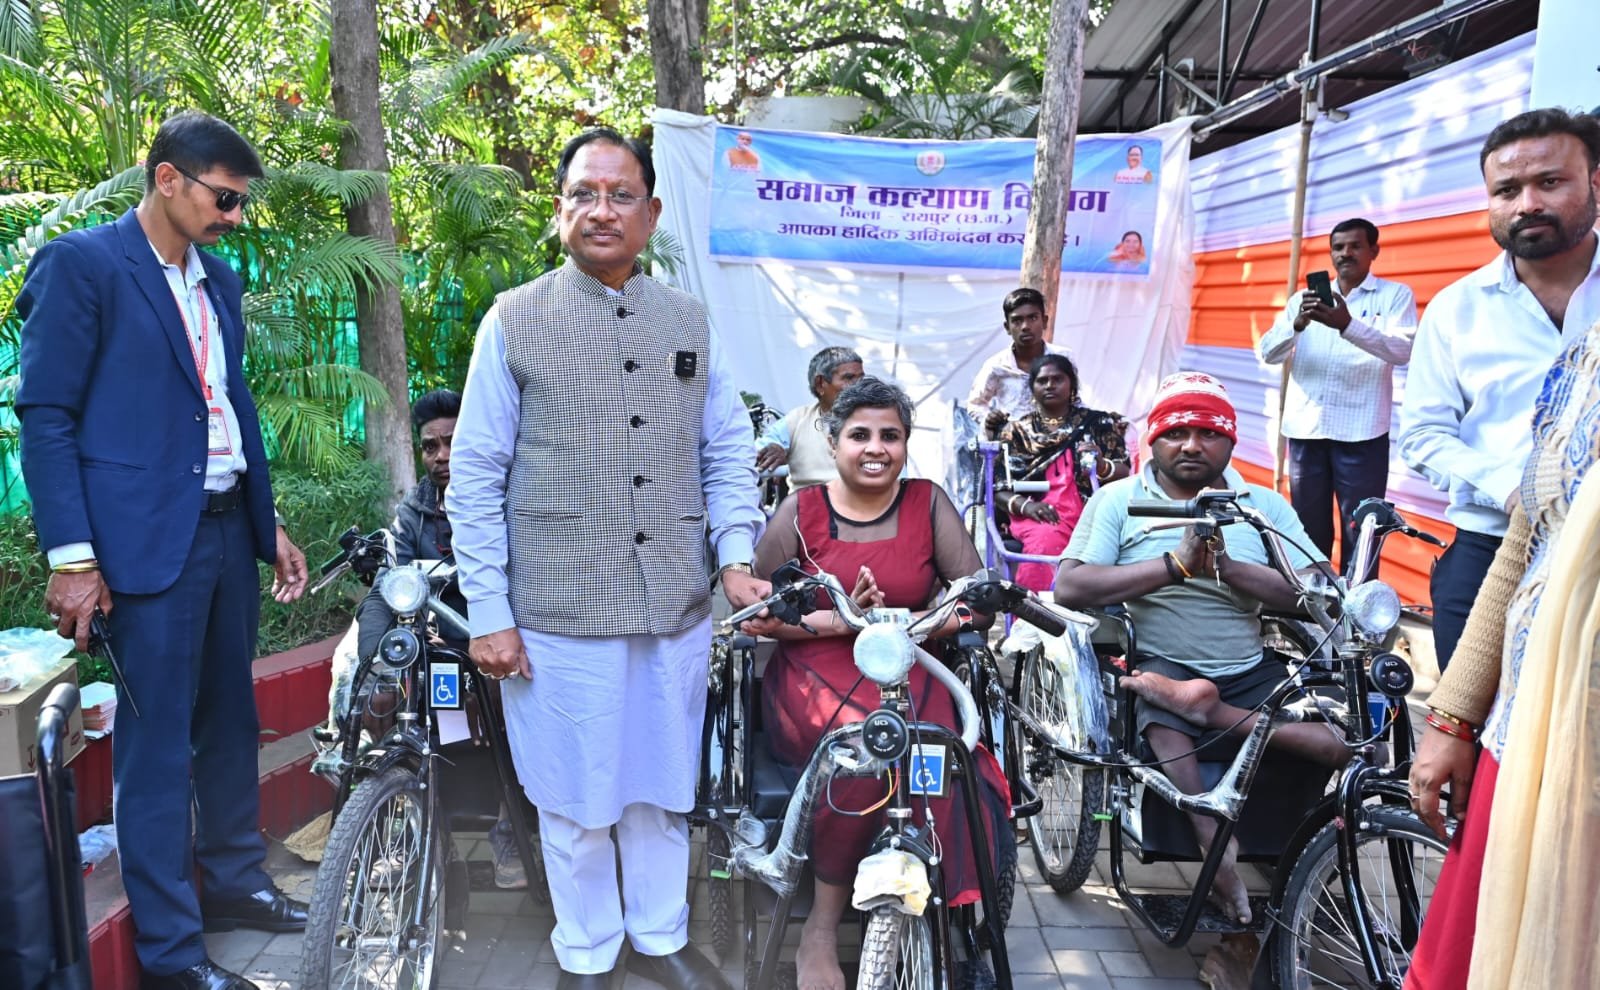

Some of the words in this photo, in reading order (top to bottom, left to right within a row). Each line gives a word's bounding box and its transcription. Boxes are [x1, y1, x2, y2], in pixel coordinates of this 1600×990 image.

[756, 179, 857, 206] समाज
[867, 186, 992, 211] कल्याण
[840, 205, 881, 220] जिला
[777, 223, 836, 237] आपका
